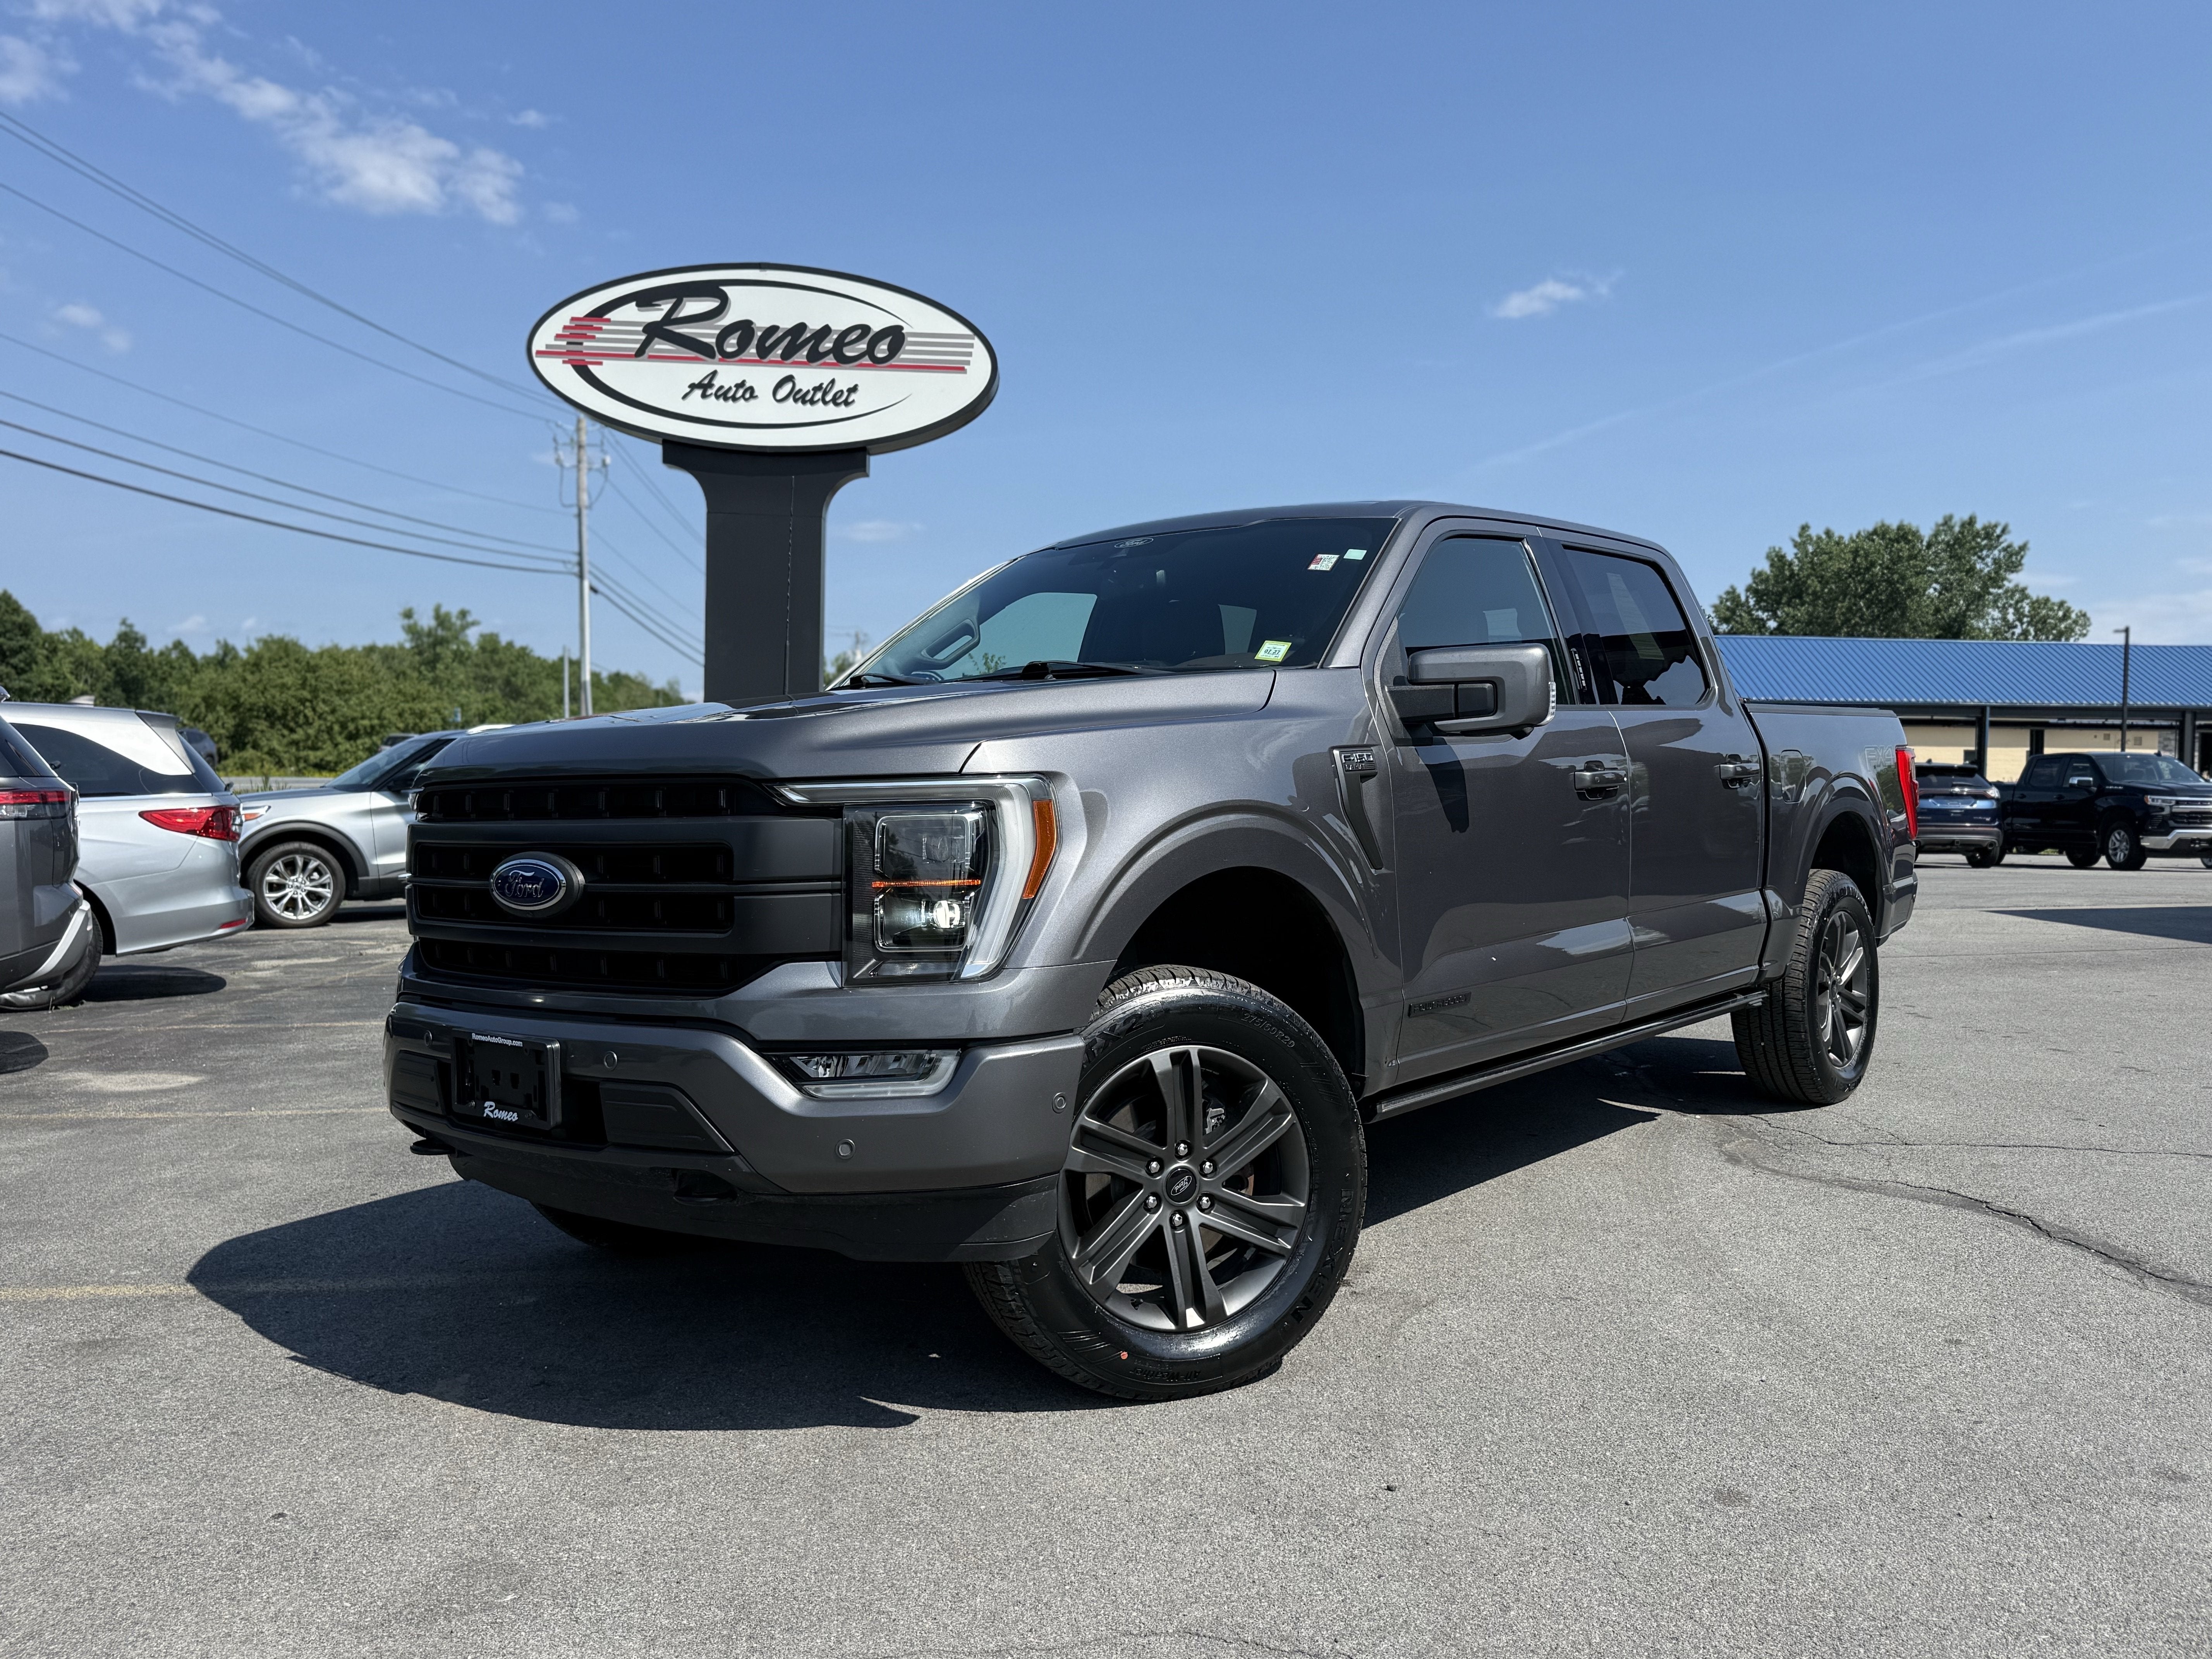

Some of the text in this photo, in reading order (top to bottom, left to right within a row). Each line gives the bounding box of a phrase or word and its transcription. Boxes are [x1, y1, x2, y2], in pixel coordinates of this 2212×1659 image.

[635, 285, 907, 366] Romeo
[682, 370, 859, 407] Auto Outlet
[505, 870, 544, 897] Ford
[472, 1033, 523, 1047] RomeoAutoGroup.com
[483, 1101, 518, 1122] Romeo
[1174, 1178, 1188, 1193] Ford
[1290, 1188, 1354, 1324] NEXEN
